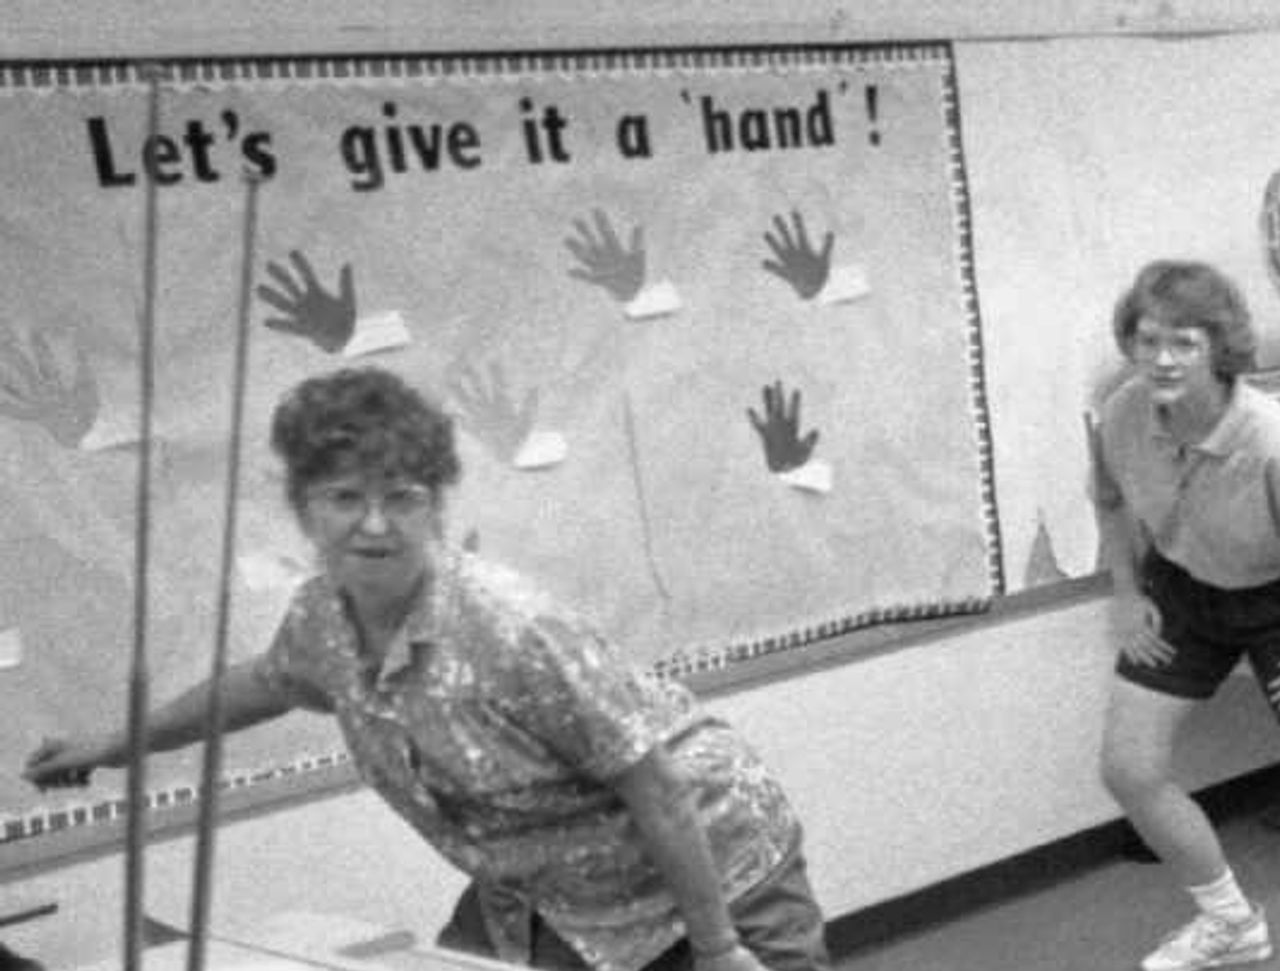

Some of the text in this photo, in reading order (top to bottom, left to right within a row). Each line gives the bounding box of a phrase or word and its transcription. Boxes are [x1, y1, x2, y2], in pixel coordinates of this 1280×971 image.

[87, 108, 277, 188] Let's
[340, 101, 482, 192] give
[519, 97, 570, 162] it
[617, 115, 652, 159] a
